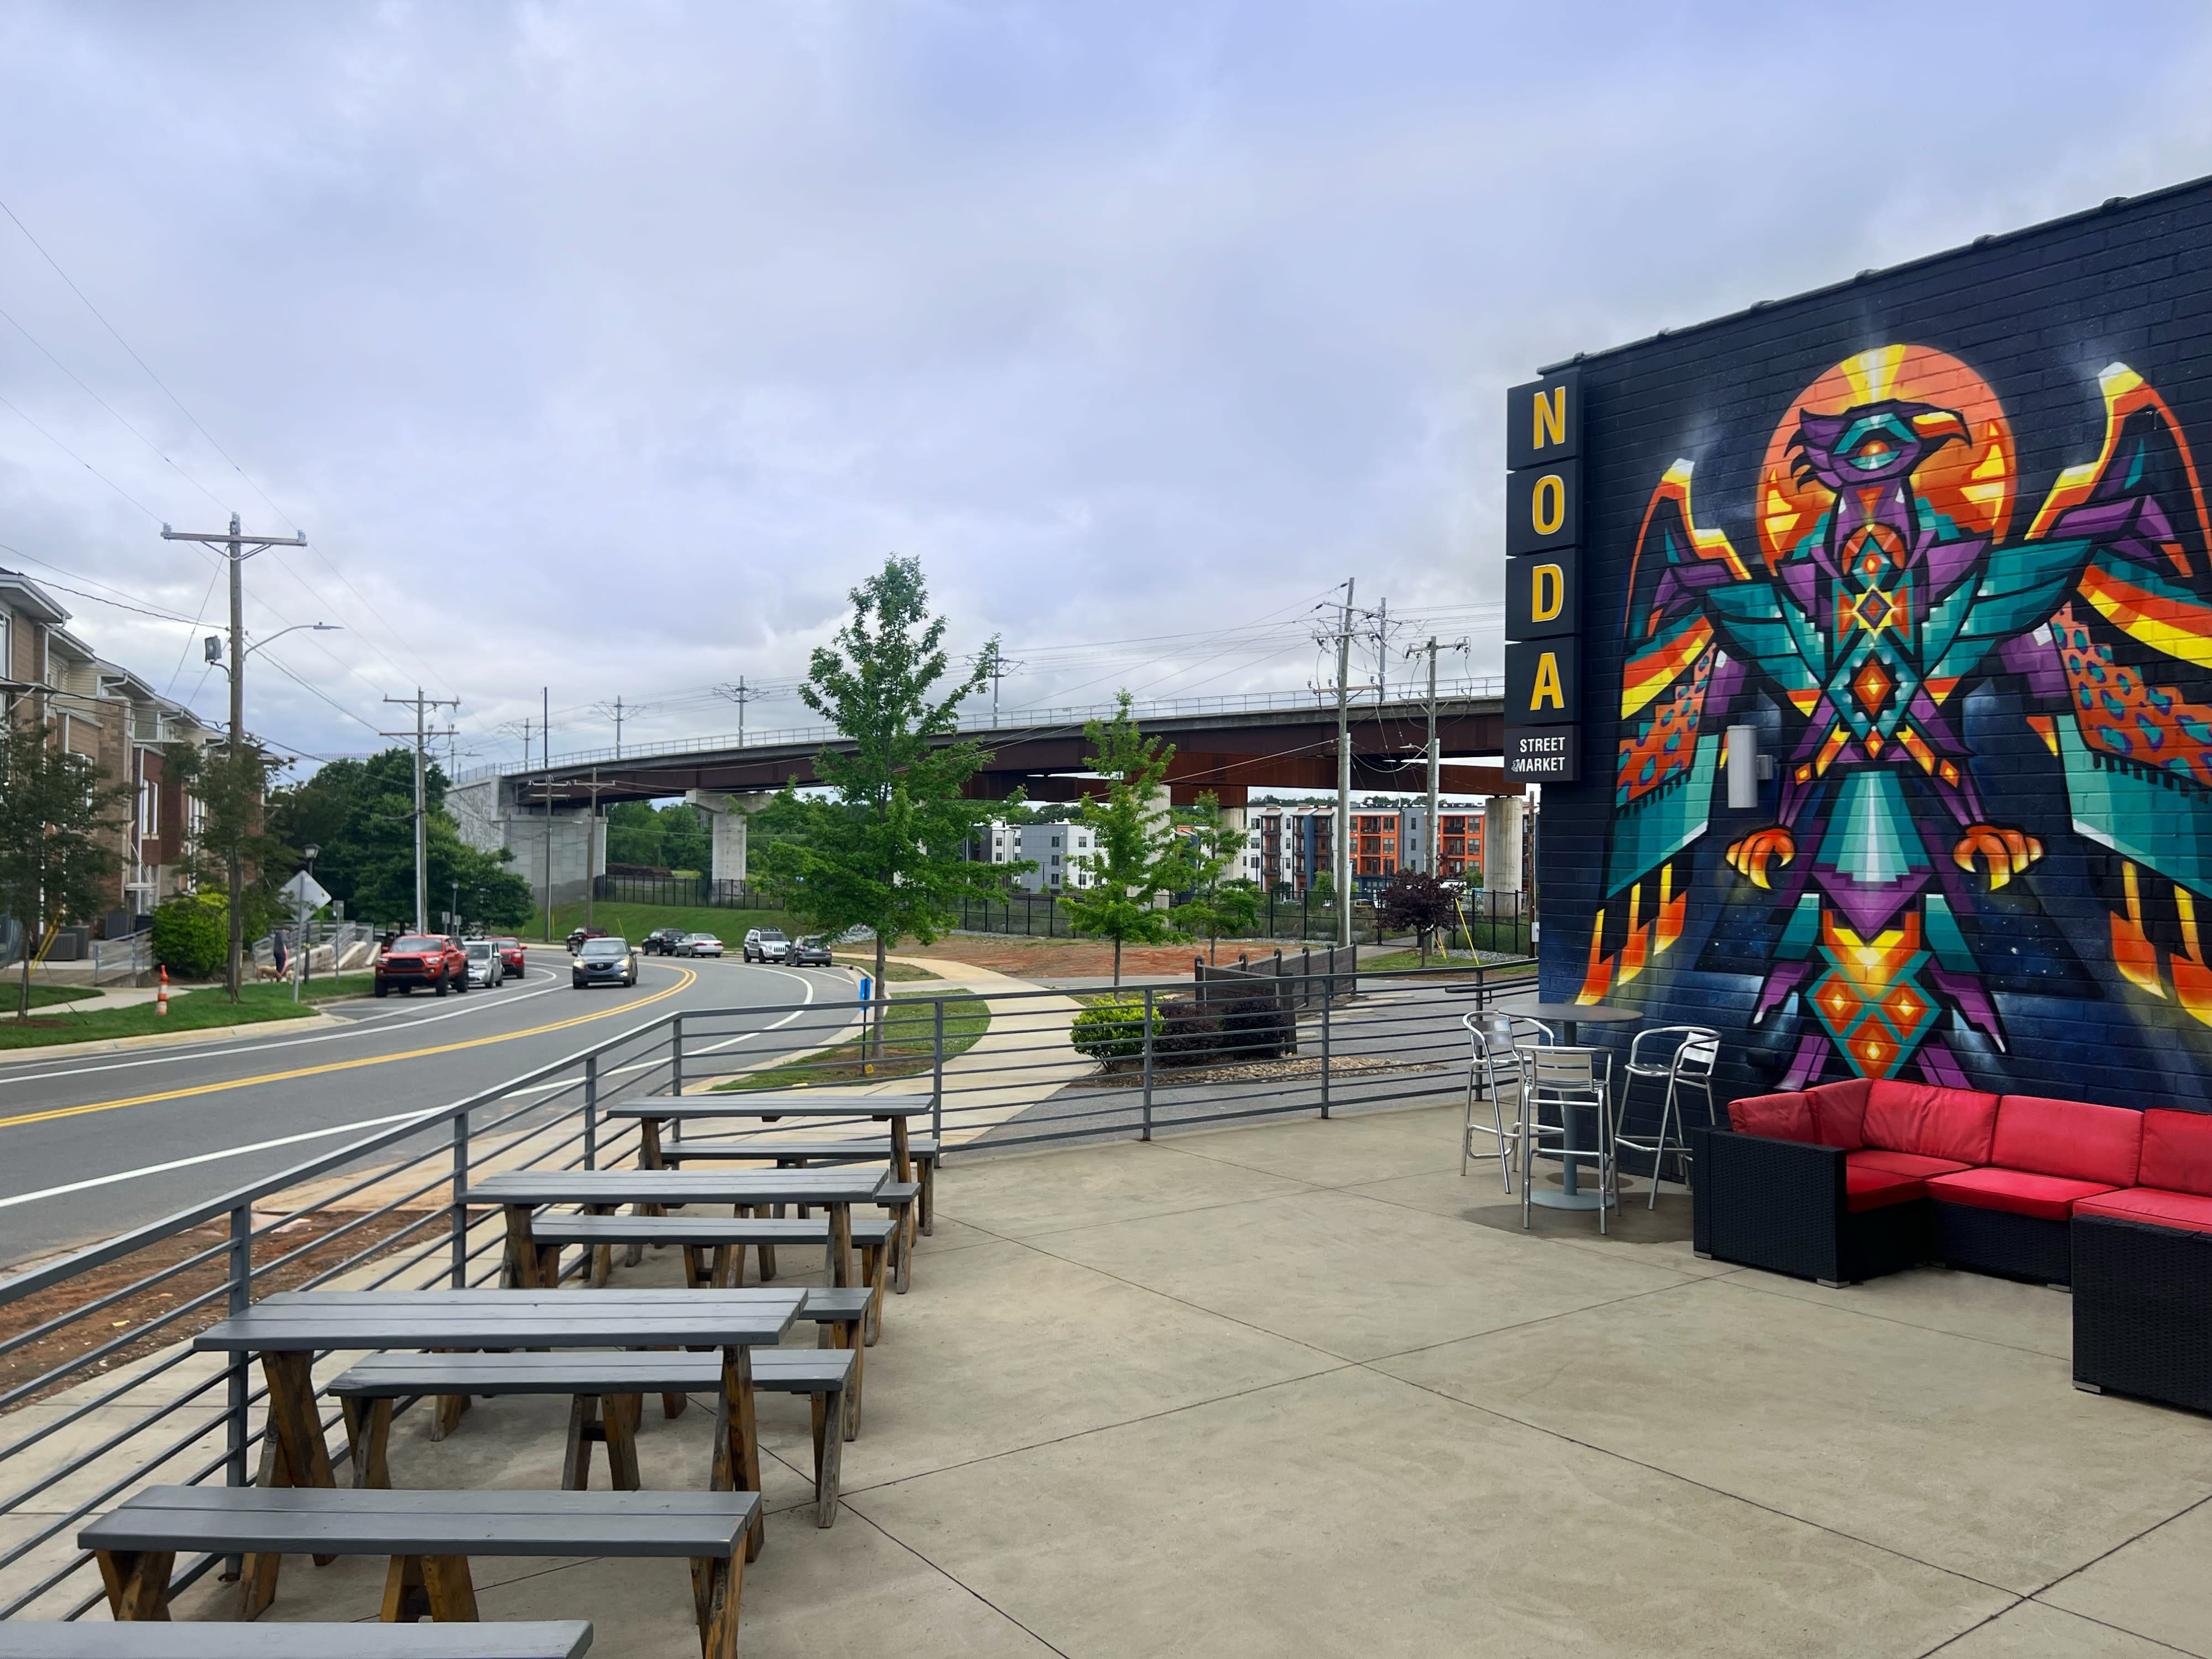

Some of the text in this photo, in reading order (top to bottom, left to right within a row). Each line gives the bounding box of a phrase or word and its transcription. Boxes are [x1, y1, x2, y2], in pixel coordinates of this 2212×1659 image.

[1530, 385, 1566, 711] NODA
[1520, 737, 1566, 753] STREET
[1516, 757, 1566, 772] MARKET
